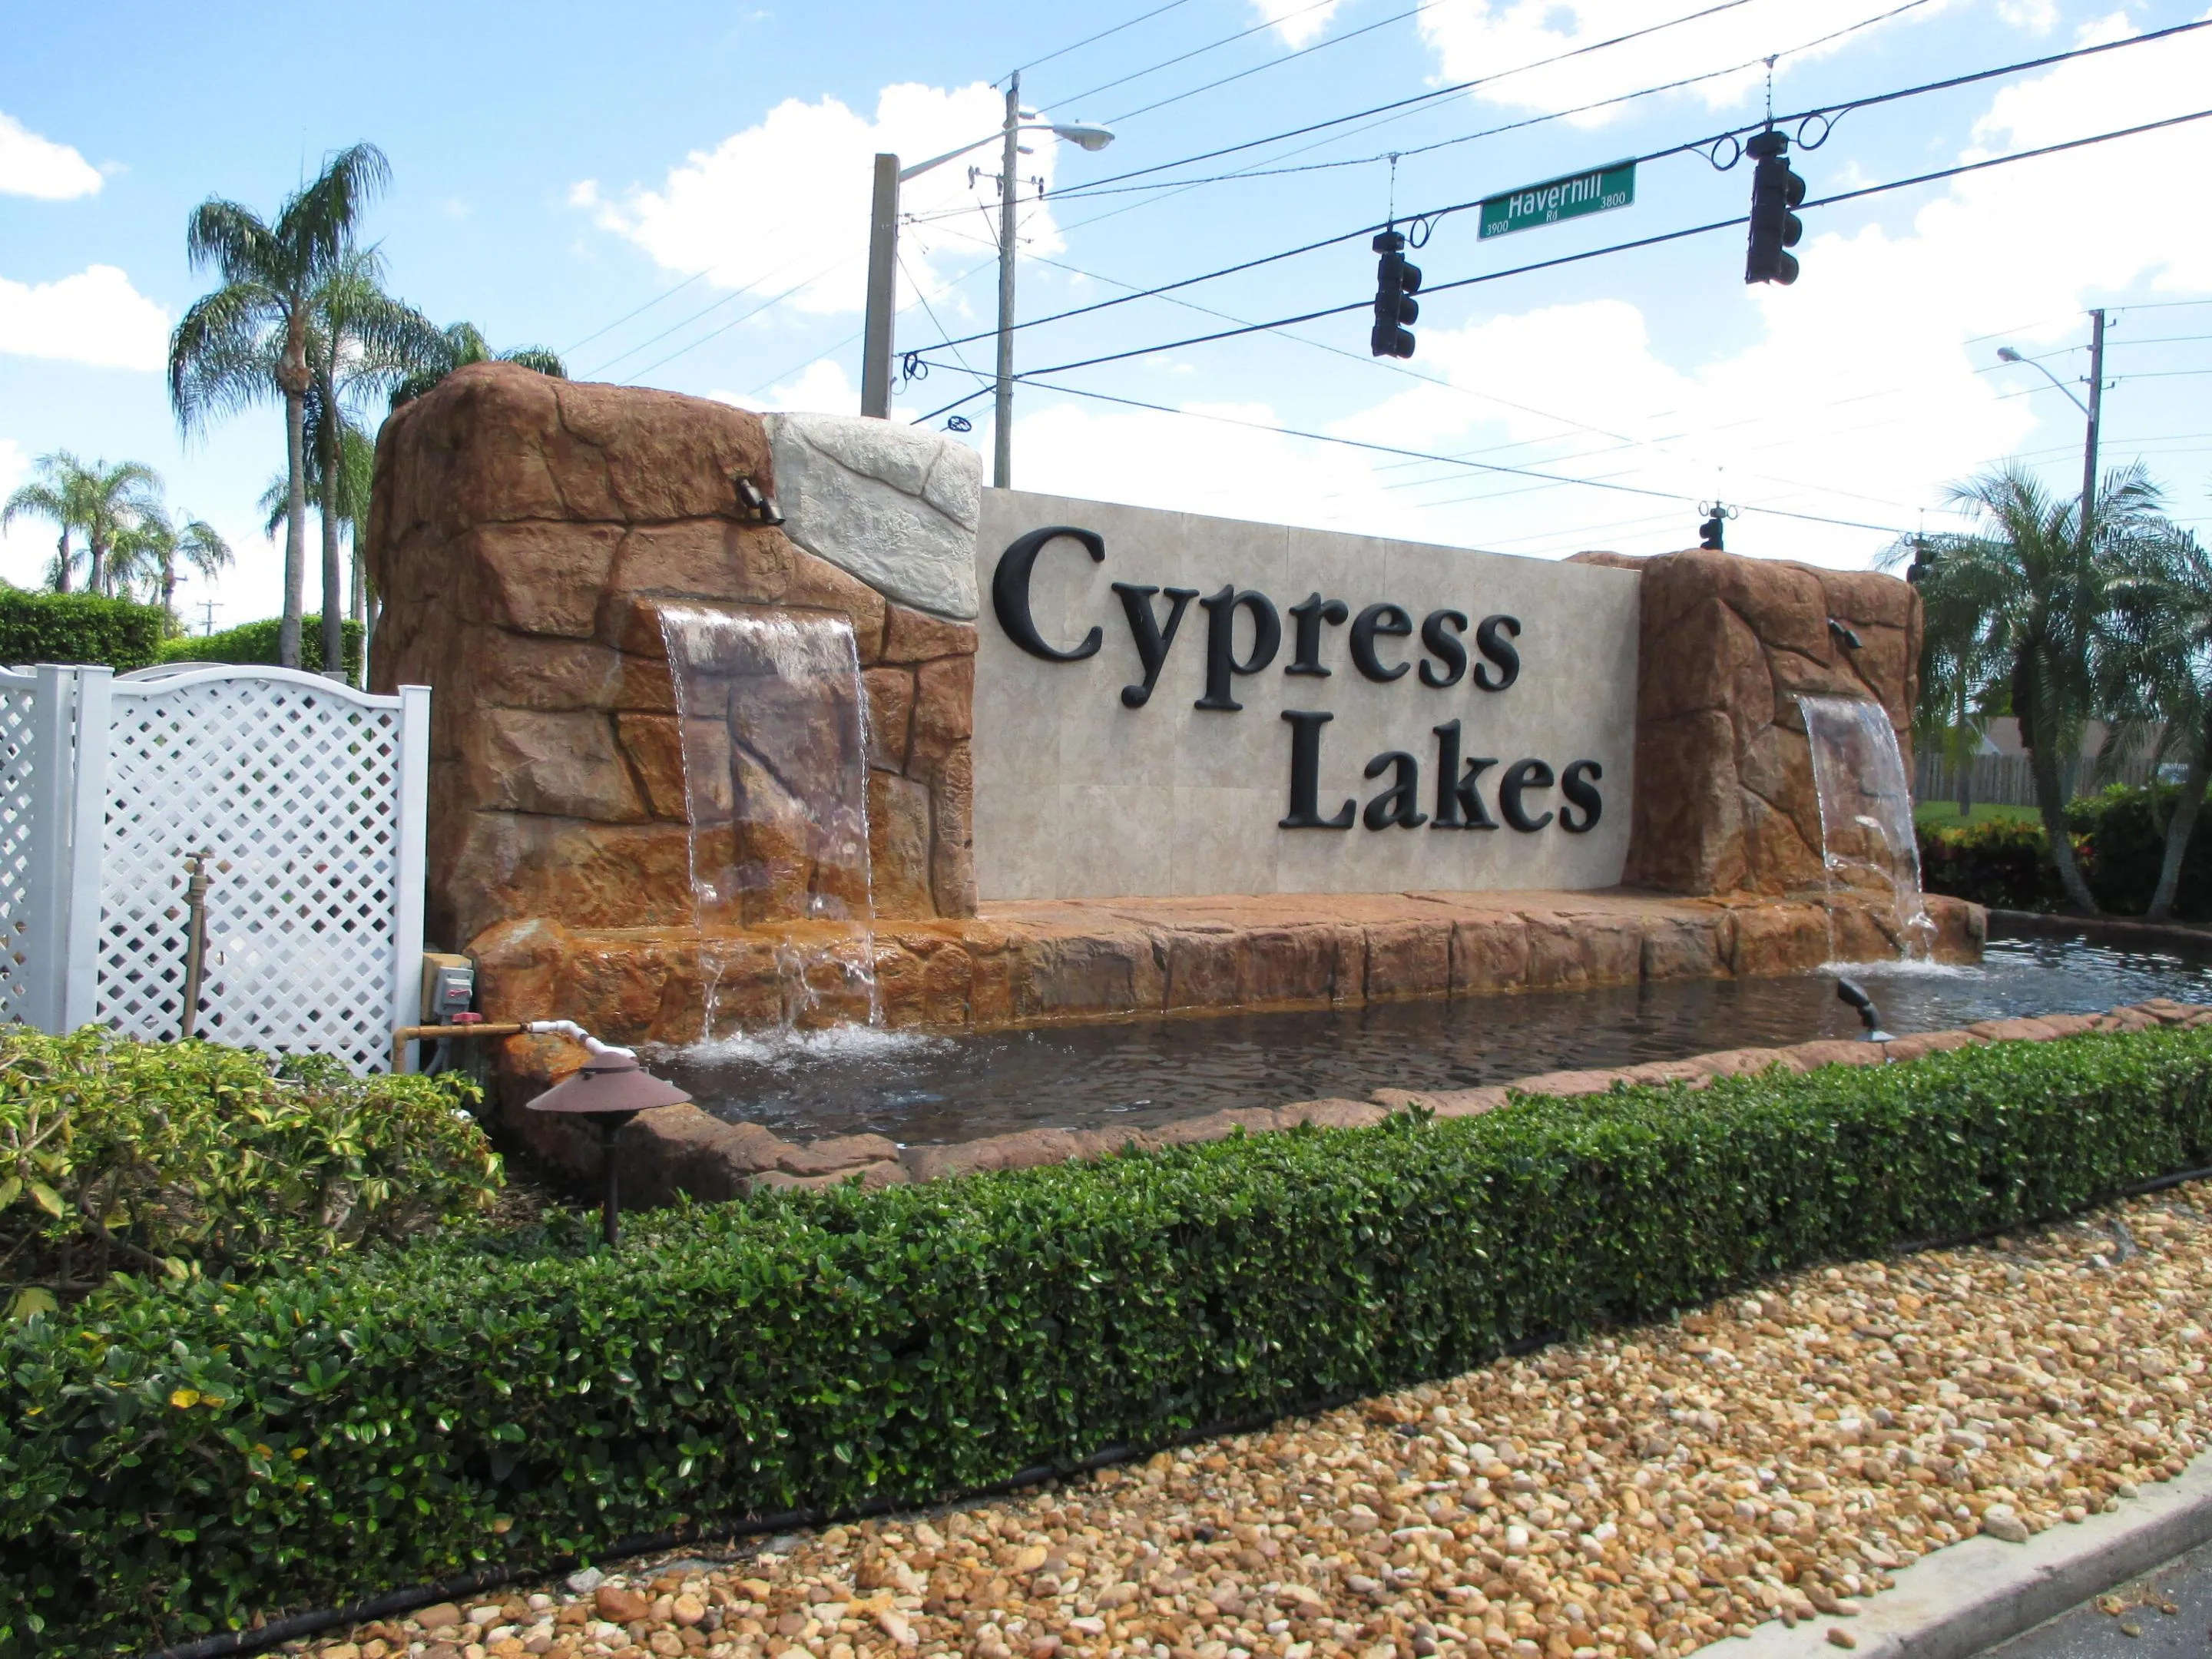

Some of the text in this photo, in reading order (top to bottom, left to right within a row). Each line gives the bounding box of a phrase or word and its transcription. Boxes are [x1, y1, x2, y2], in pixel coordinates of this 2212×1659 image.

[1508, 174, 1602, 219] Haverhill
[1600, 191, 1625, 210] 3800
[1486, 220, 1508, 236] 3900
[1546, 210, 1558, 222] Rd
[992, 525, 1522, 710] Cypress
[1278, 709, 1603, 833] Lakes
